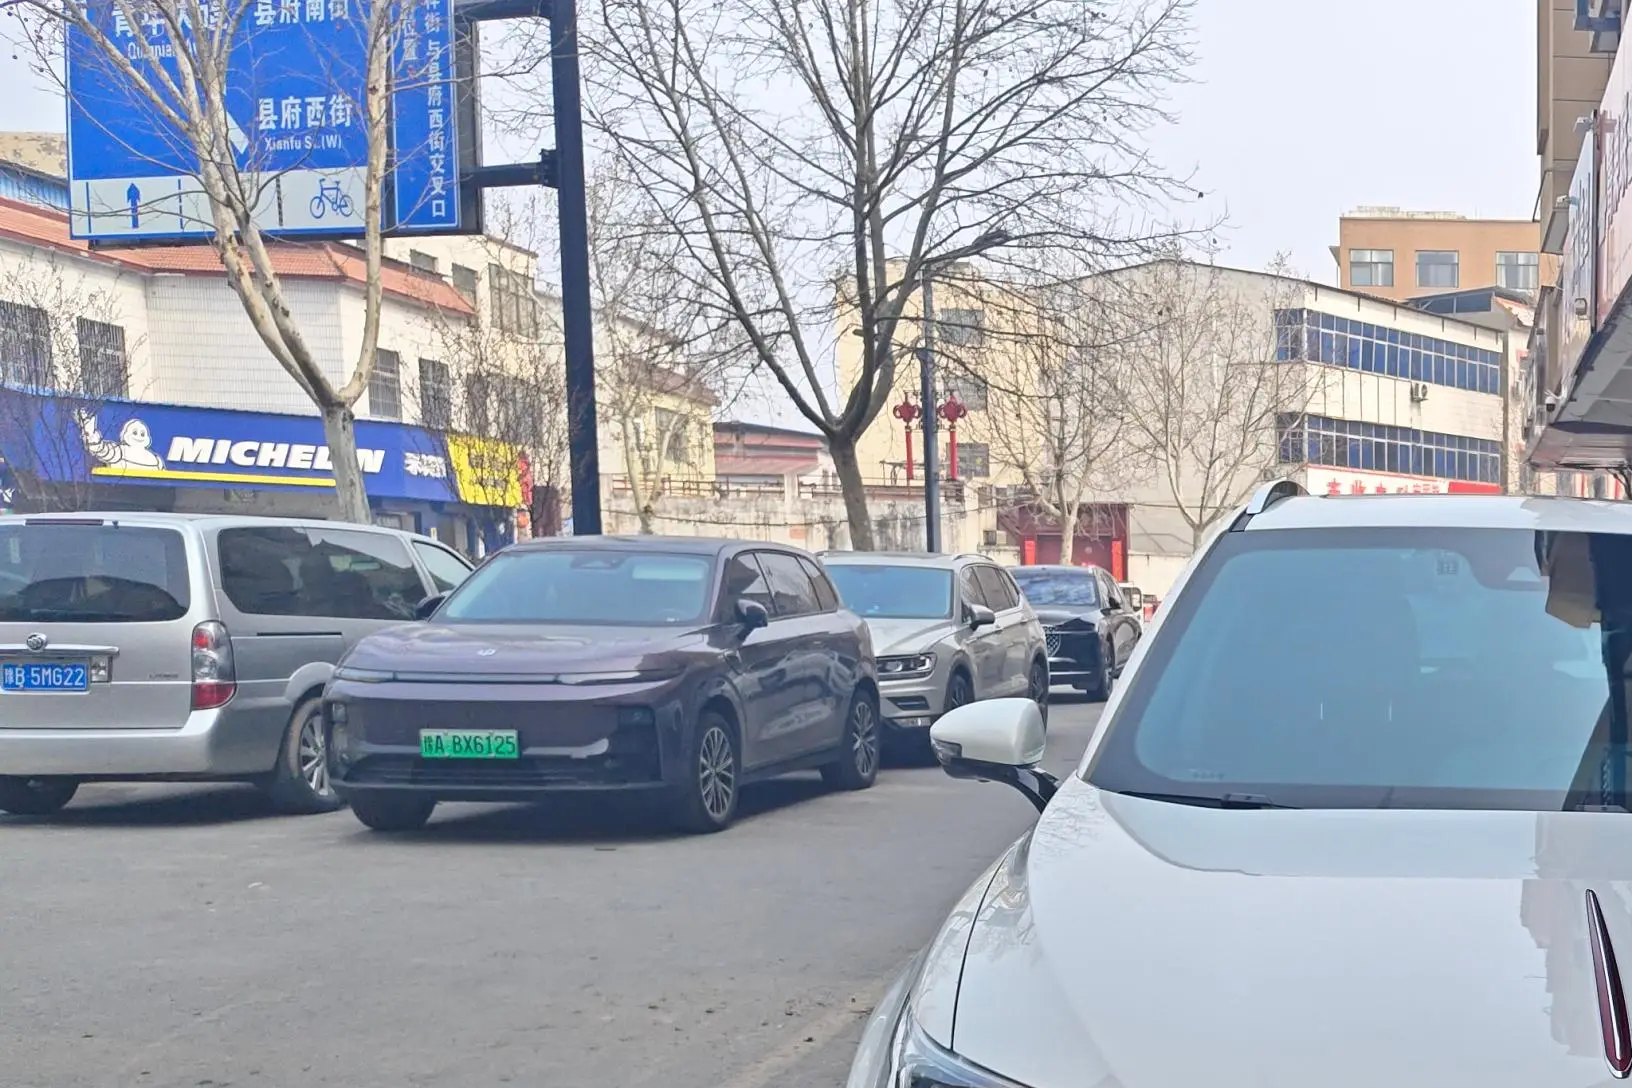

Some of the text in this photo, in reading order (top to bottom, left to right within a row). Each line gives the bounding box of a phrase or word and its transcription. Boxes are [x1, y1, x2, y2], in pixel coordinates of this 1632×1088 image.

[258, 96, 352, 130] 县府西街
[167, 437, 385, 474] MICHELN
